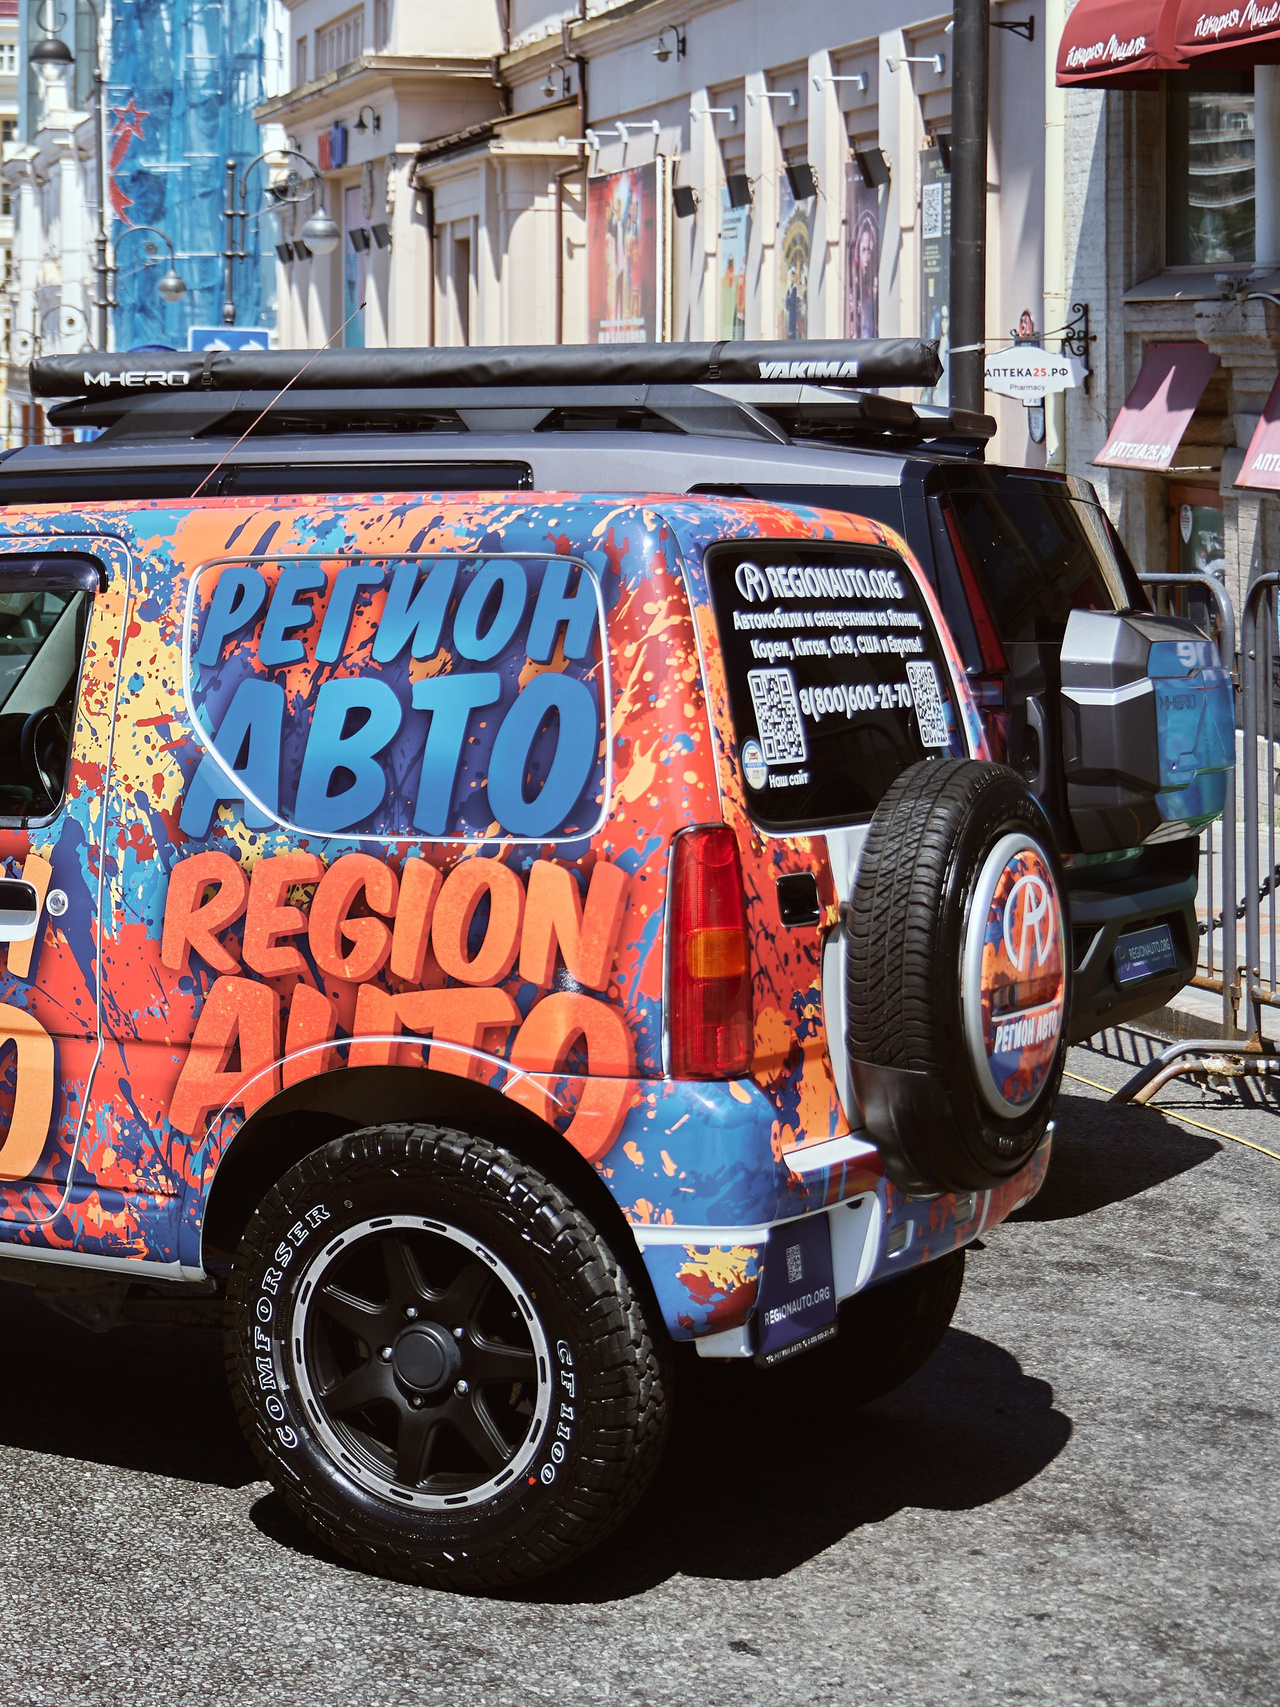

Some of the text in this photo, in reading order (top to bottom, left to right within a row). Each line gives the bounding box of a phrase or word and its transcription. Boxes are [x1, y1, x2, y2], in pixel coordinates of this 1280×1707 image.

[84, 371, 190, 387] MHERO
[758, 361, 858, 379] YAKIMA
[985, 367, 1069, 378] АПТЕКА25.РФ
[1009, 383, 1046, 392] Pharmacy
[765, 567, 903, 600] REGIONAUTO.ORG
[197, 551, 609, 667] РЕГИОН
[733, 607, 922, 630] Автомобили и спецтехника из Японии,
[750, 639, 795, 664] Кореи,
[792, 637, 832, 659] Китая,
[830, 635, 858, 657] ОАЭ,
[856, 635, 881, 653] США
[798, 683, 913, 722] 8(800)600-21-70
[180, 672, 600, 839] АВТО
[769, 773, 788, 788] Наш
[788, 770, 809, 786] сайт
[161, 851, 633, 990] REGION
[994, 1010, 1058, 1054] РЕГИОН АВТО
[764, 1286, 831, 1328] REGIONAUTO.ORG
[253, 1203, 331, 1449] COMFORSER
